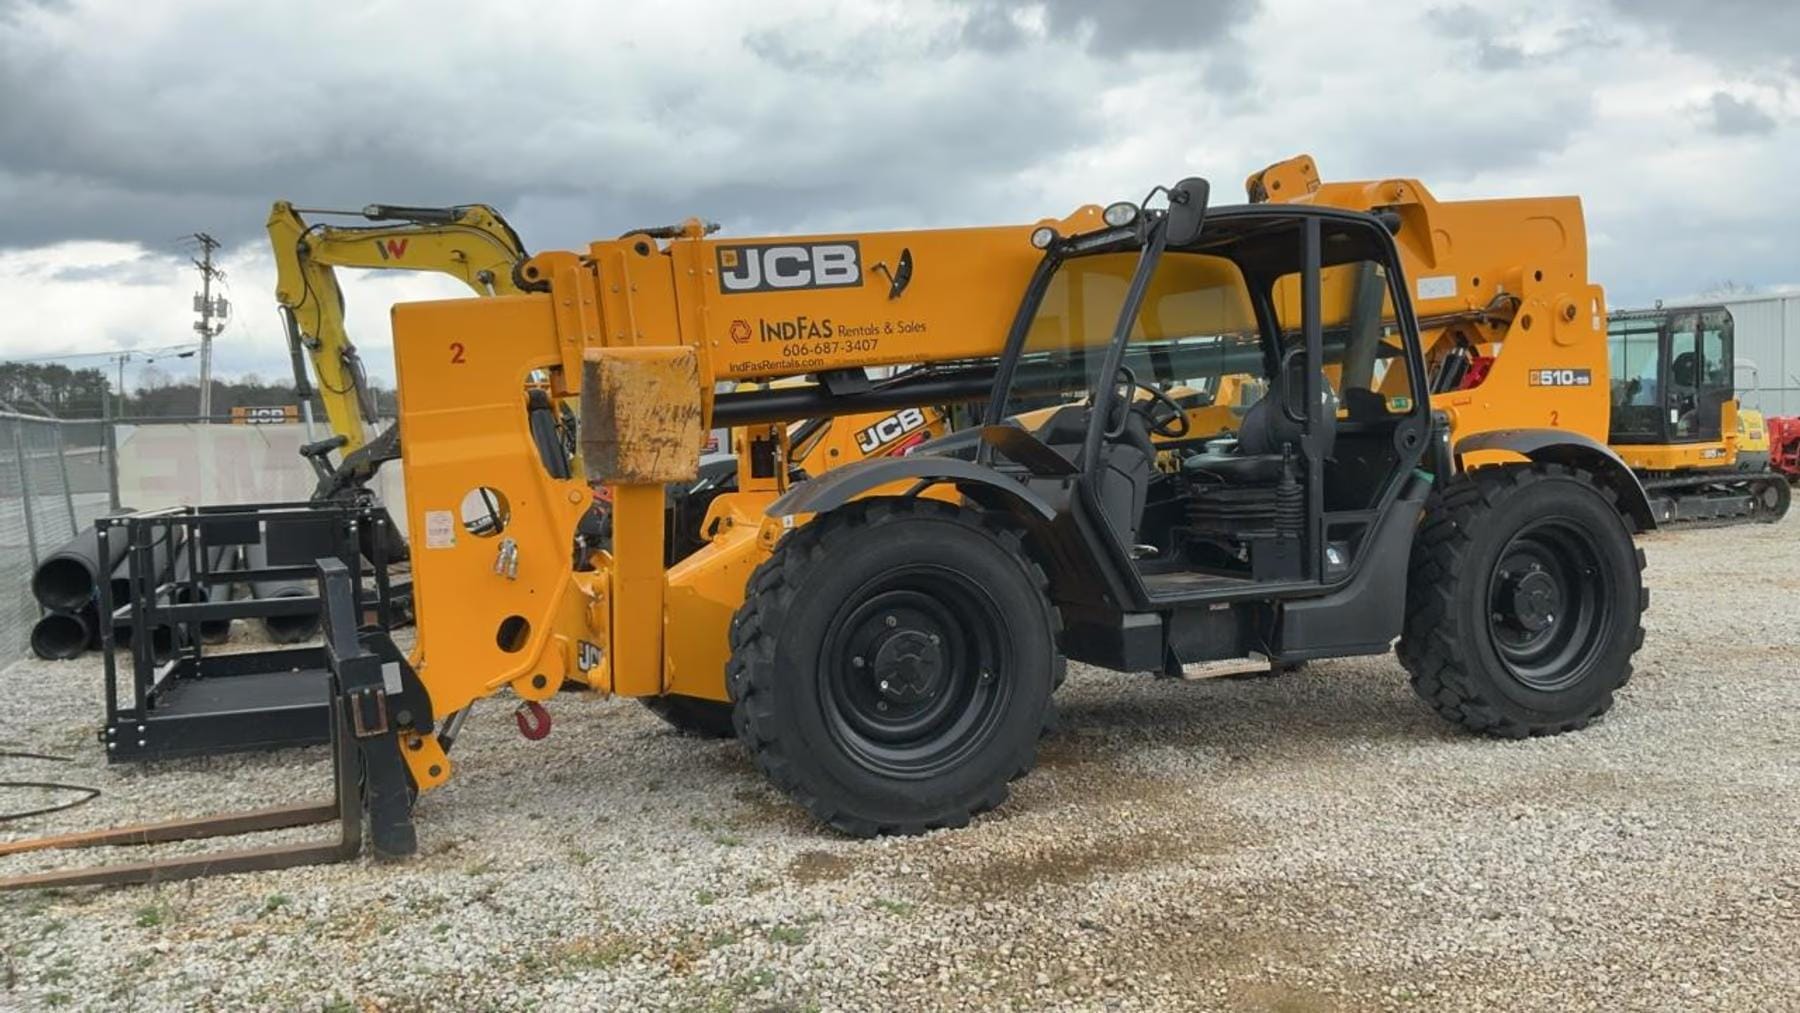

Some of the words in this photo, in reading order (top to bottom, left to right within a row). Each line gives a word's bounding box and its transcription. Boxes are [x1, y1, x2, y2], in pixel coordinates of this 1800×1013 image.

[723, 244, 860, 290] JCB
[838, 323, 880, 338] Rentals
[884, 322, 893, 334] &
[897, 320, 926, 334] Sales
[449, 342, 466, 364] 2
[782, 338, 879, 357] 606-687-3407
[729, 357, 824, 373] IndFasRentals.com
[1550, 410, 1559, 426] 2
[861, 408, 924, 452] JCB
[579, 643, 603, 671] JC
